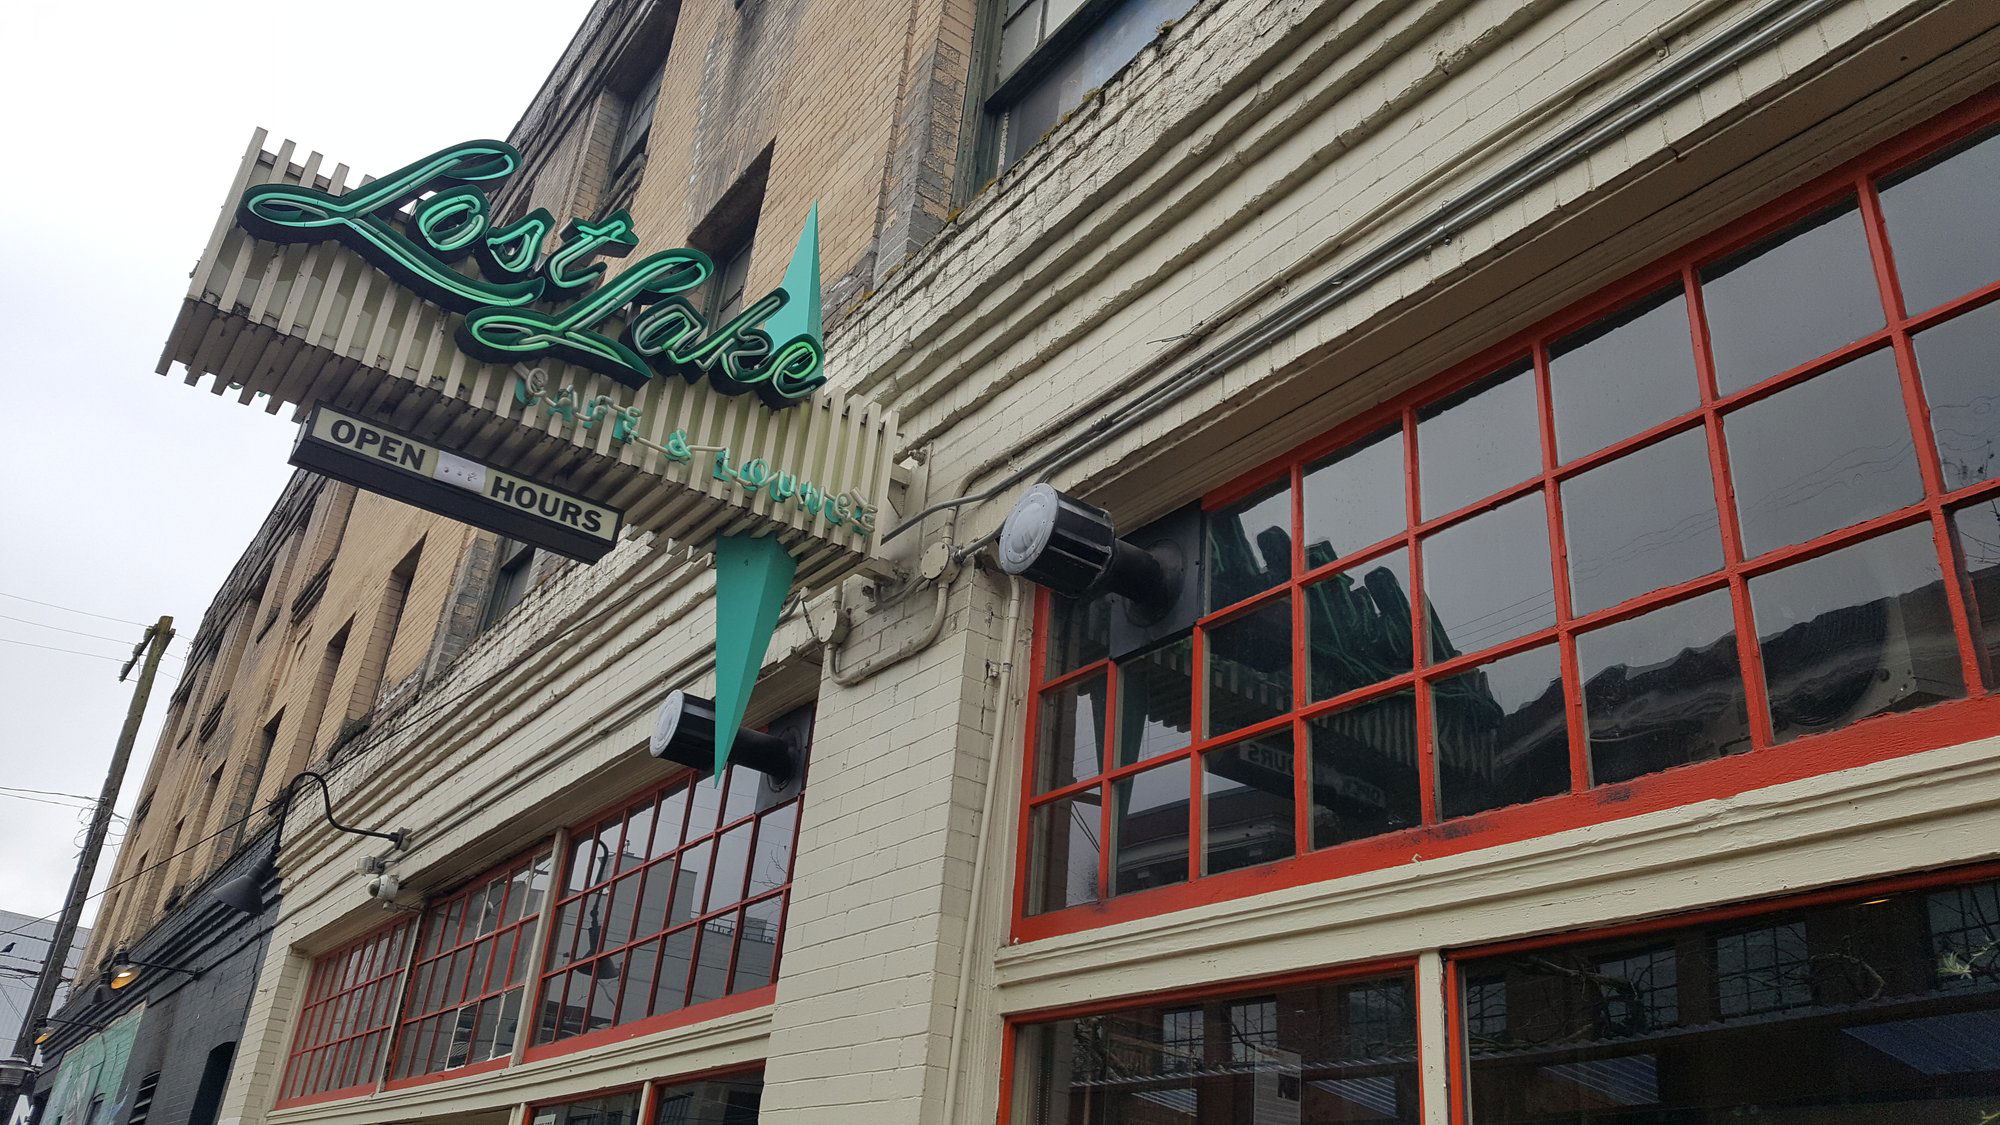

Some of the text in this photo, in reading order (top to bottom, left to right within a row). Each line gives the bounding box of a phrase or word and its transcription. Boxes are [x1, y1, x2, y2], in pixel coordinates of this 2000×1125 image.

[238, 138, 640, 316] Lost
[458, 247, 827, 406] Lake
[330, 418, 602, 533] OPEN HOURS
[512, 364, 879, 535] CAFE & LOUNGE
